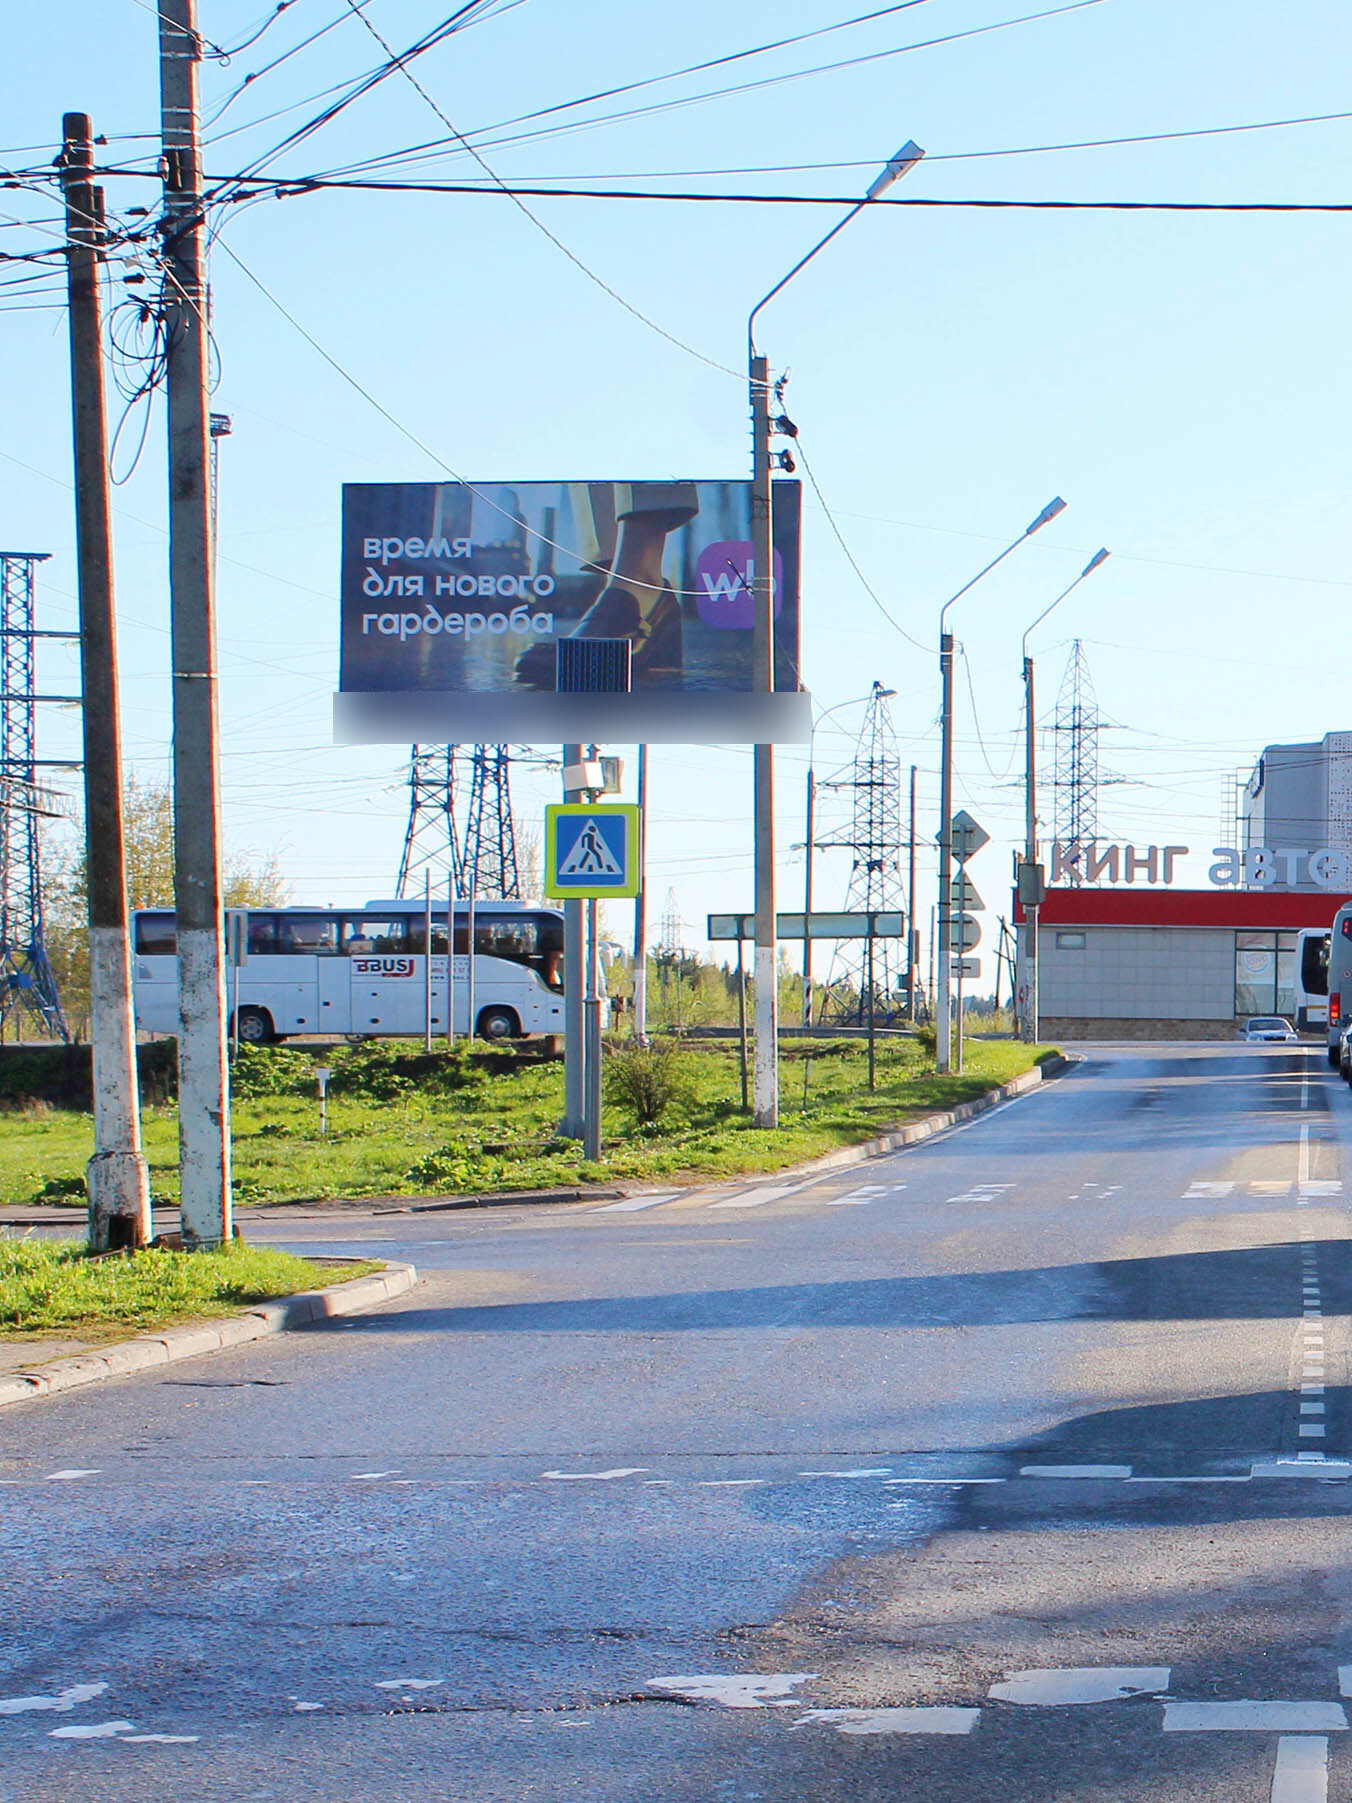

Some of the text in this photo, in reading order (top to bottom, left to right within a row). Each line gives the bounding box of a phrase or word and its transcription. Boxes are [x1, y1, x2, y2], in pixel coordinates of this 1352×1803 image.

[363, 536, 473, 566] время
[362, 567, 555, 598] для нового
[362, 604, 554, 641] гардероба
